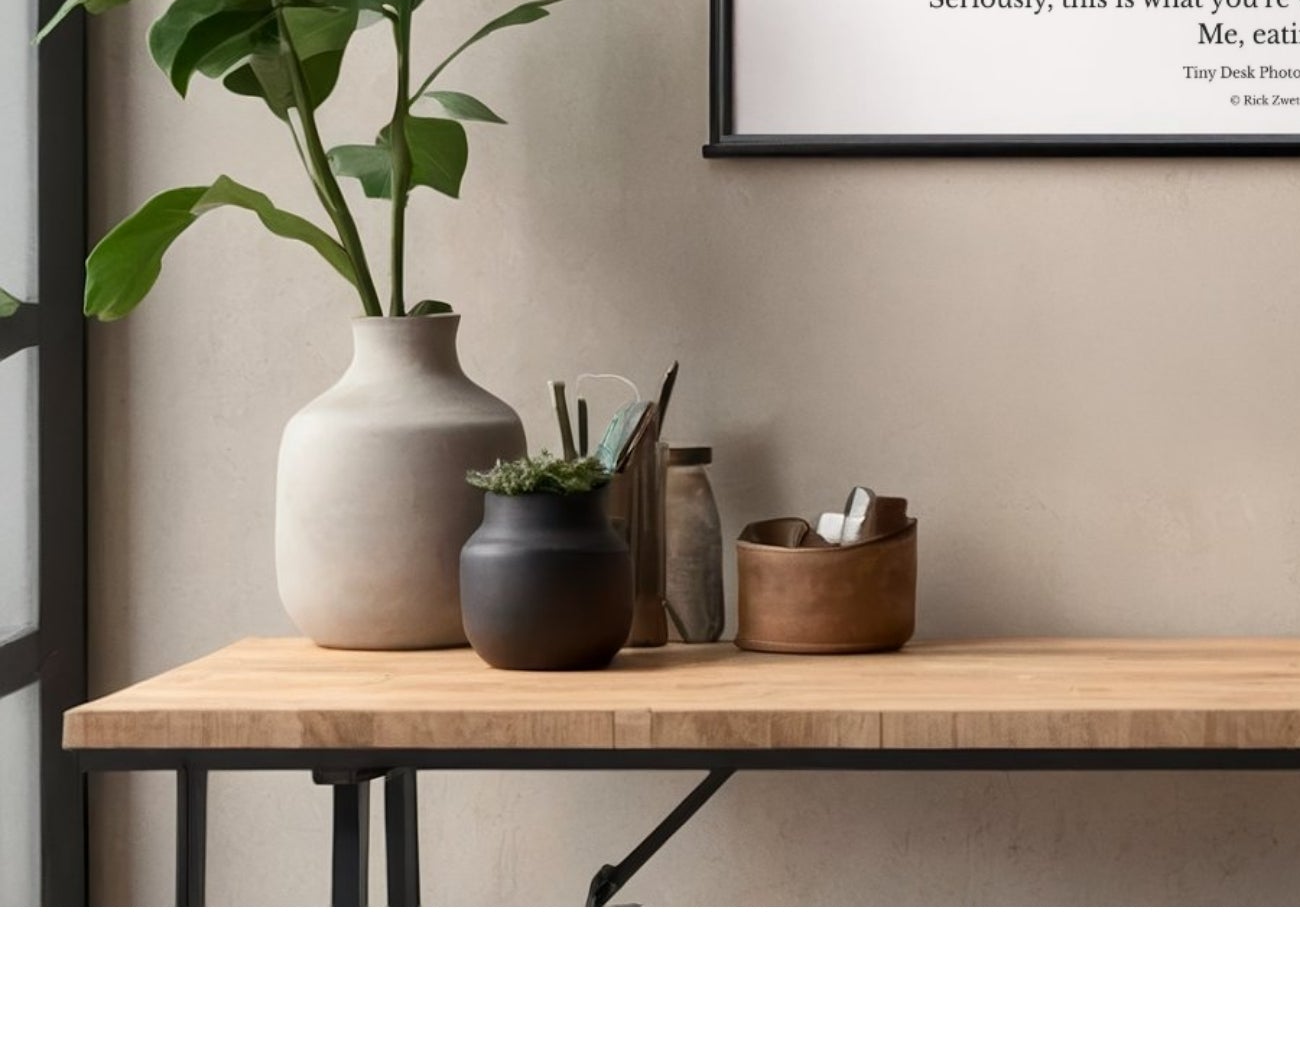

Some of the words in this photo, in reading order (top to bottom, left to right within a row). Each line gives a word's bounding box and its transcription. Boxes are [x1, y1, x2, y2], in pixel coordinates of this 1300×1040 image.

[1198, 23, 1244, 47] Me,
[1182, 65, 1217, 83] Tiny
[1220, 64, 1256, 80] Desk
[1243, 94, 1269, 106] Rick
